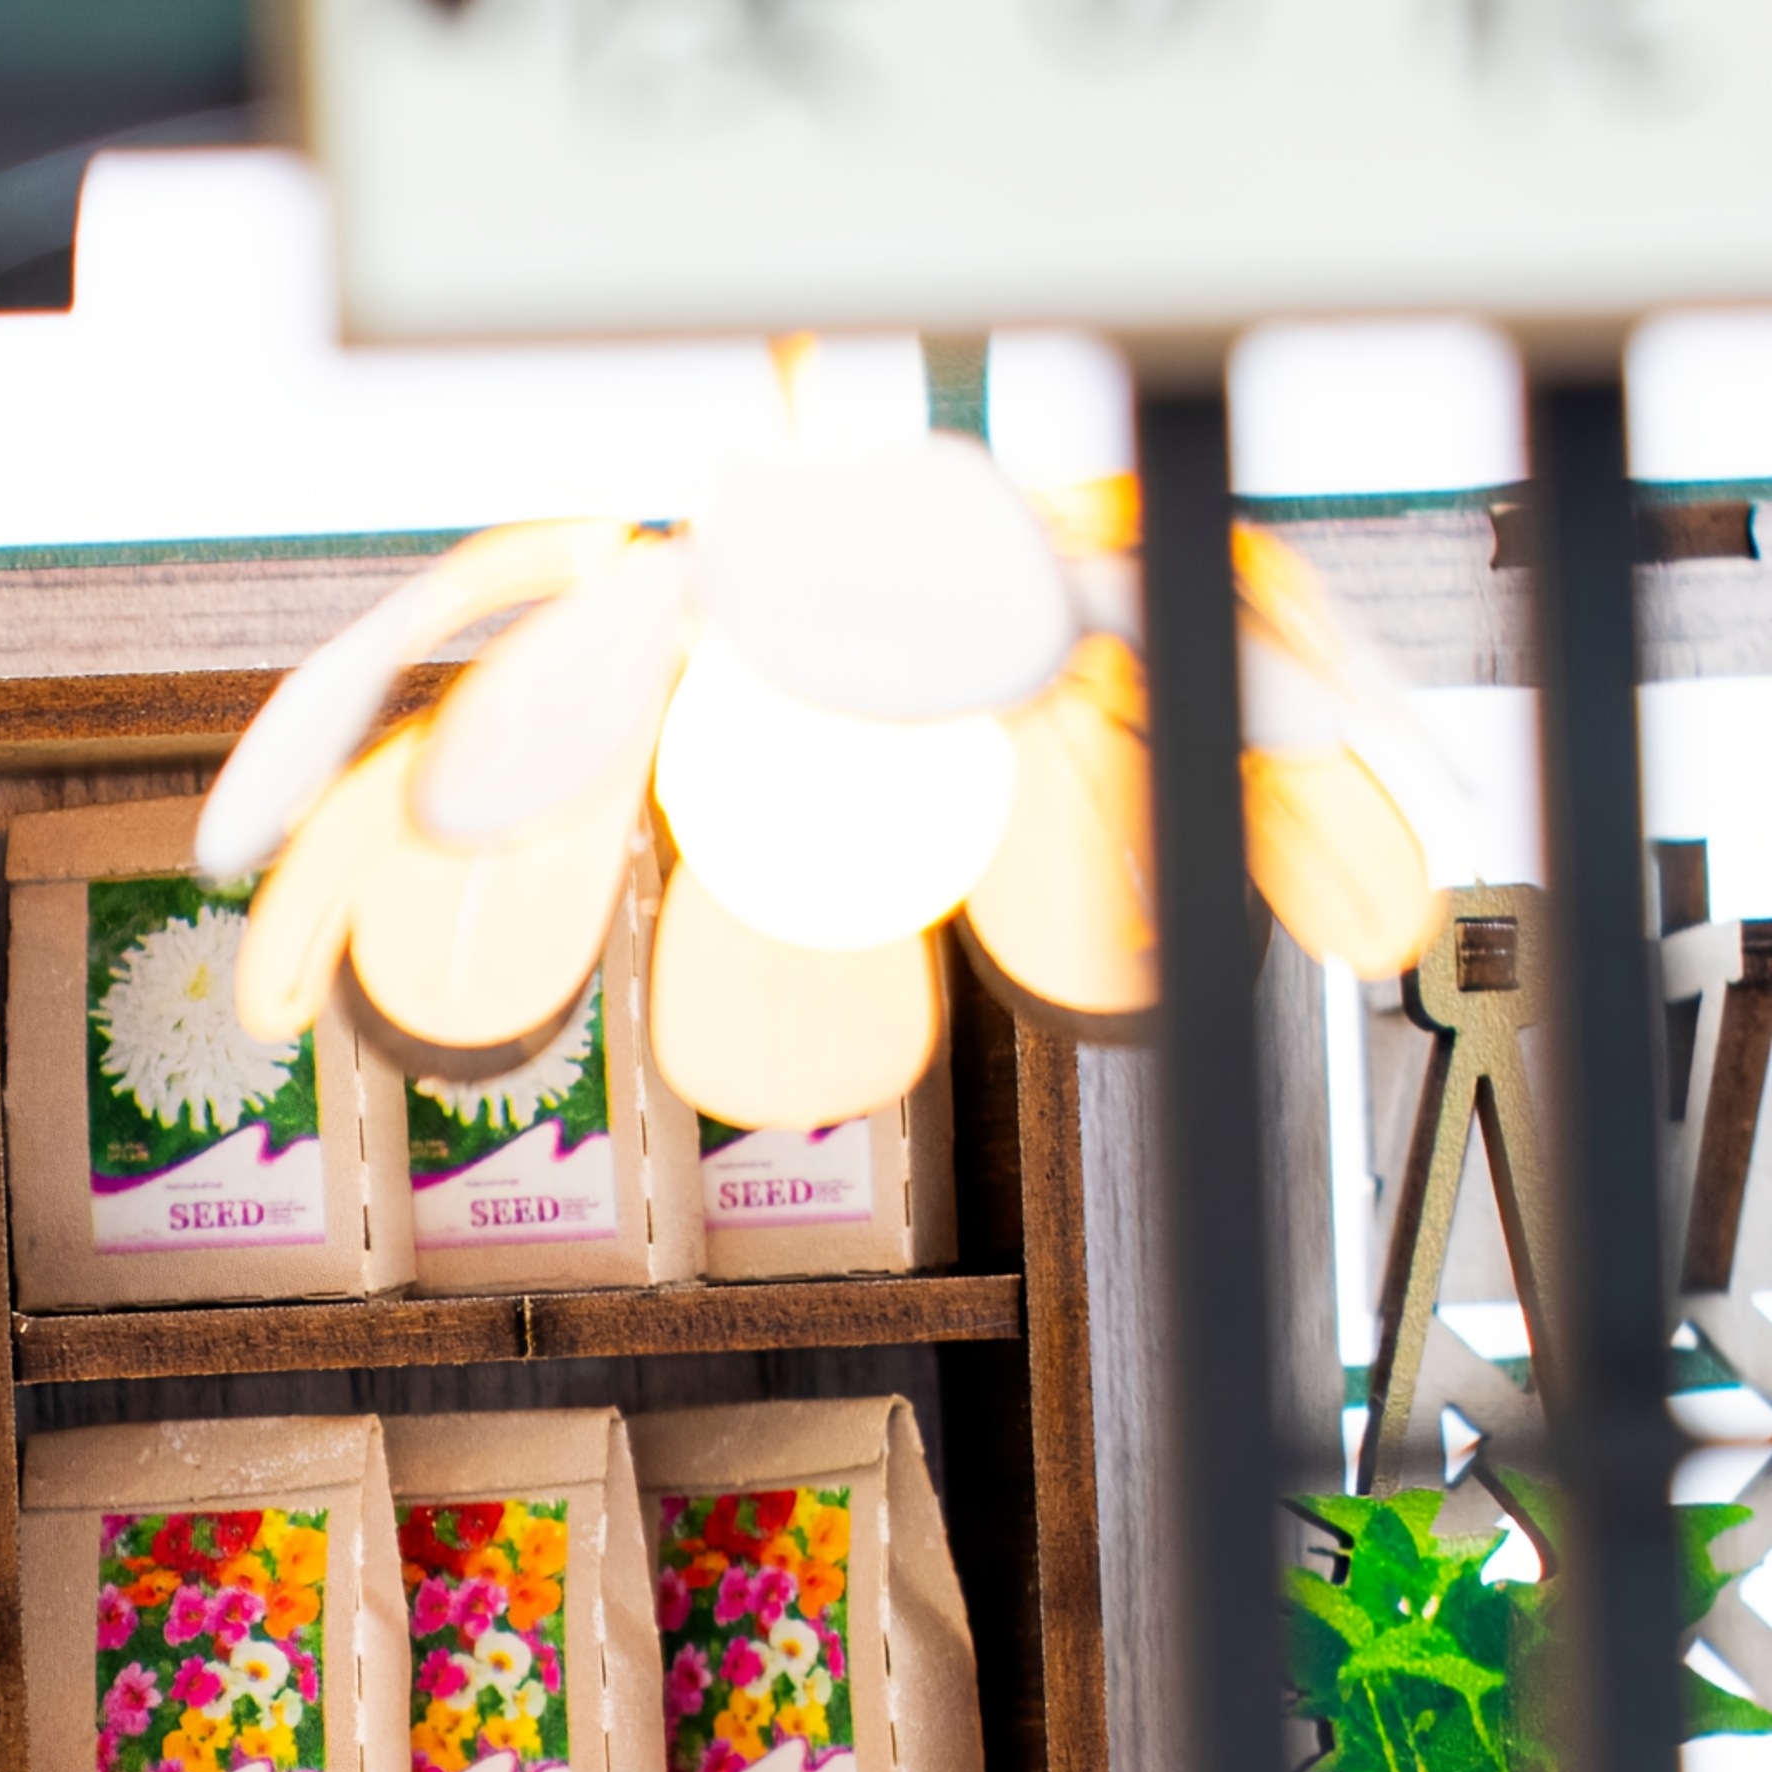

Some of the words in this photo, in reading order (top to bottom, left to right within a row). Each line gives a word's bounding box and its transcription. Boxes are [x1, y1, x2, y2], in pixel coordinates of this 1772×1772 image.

[718, 1178, 813, 1210] SEED
[168, 1200, 264, 1231] SEED
[470, 1196, 560, 1227] SEED
